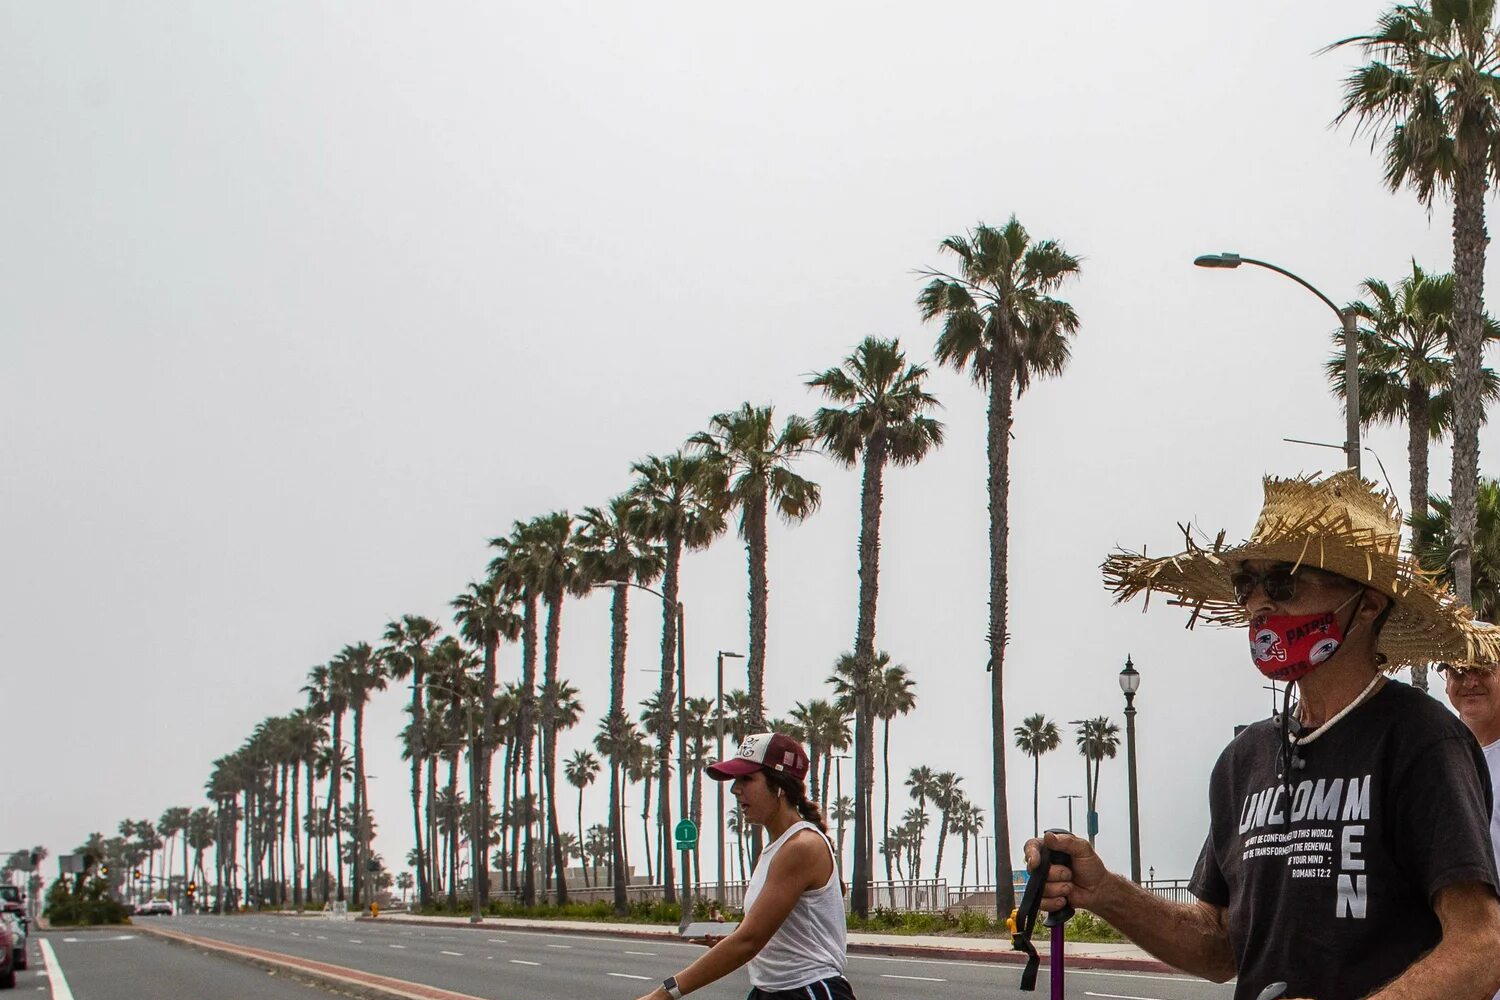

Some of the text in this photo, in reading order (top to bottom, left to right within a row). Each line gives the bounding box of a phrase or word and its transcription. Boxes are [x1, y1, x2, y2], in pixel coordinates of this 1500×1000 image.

[1297, 828, 1310, 839] THIS
[1310, 828, 1334, 838] WORLD.
[1294, 842, 1304, 852] THE
[1303, 842, 1333, 852] RENEWAL
[1292, 855, 1307, 865] YOUR
[1292, 868, 1331, 878] ROMANS 12:2
